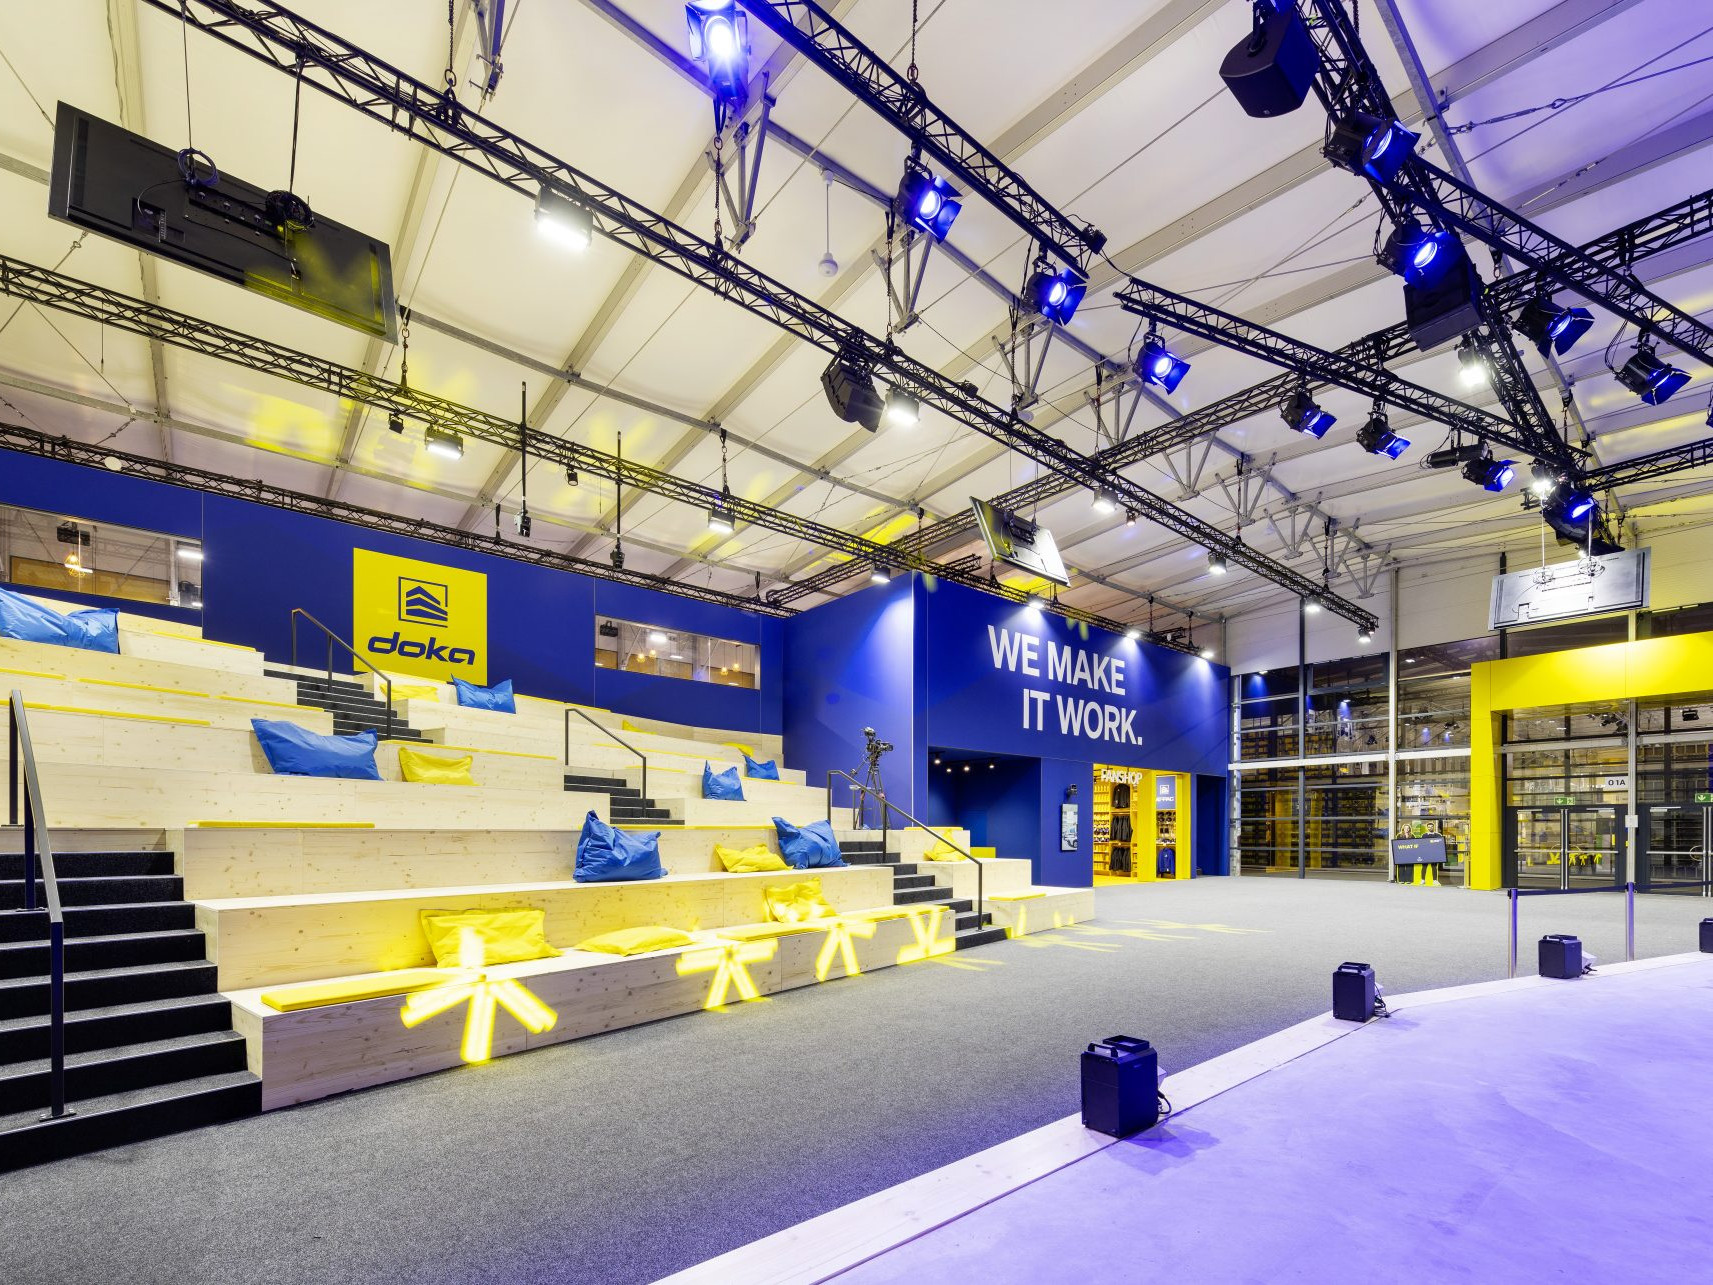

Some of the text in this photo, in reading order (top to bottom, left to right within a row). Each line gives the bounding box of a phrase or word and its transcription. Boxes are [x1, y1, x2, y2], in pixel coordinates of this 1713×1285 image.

[367, 632, 476, 665] doka
[988, 625, 1126, 696] WE MAKE
[1023, 688, 1143, 746] IT WORK.
[1101, 768, 1143, 785] FANSHOP
